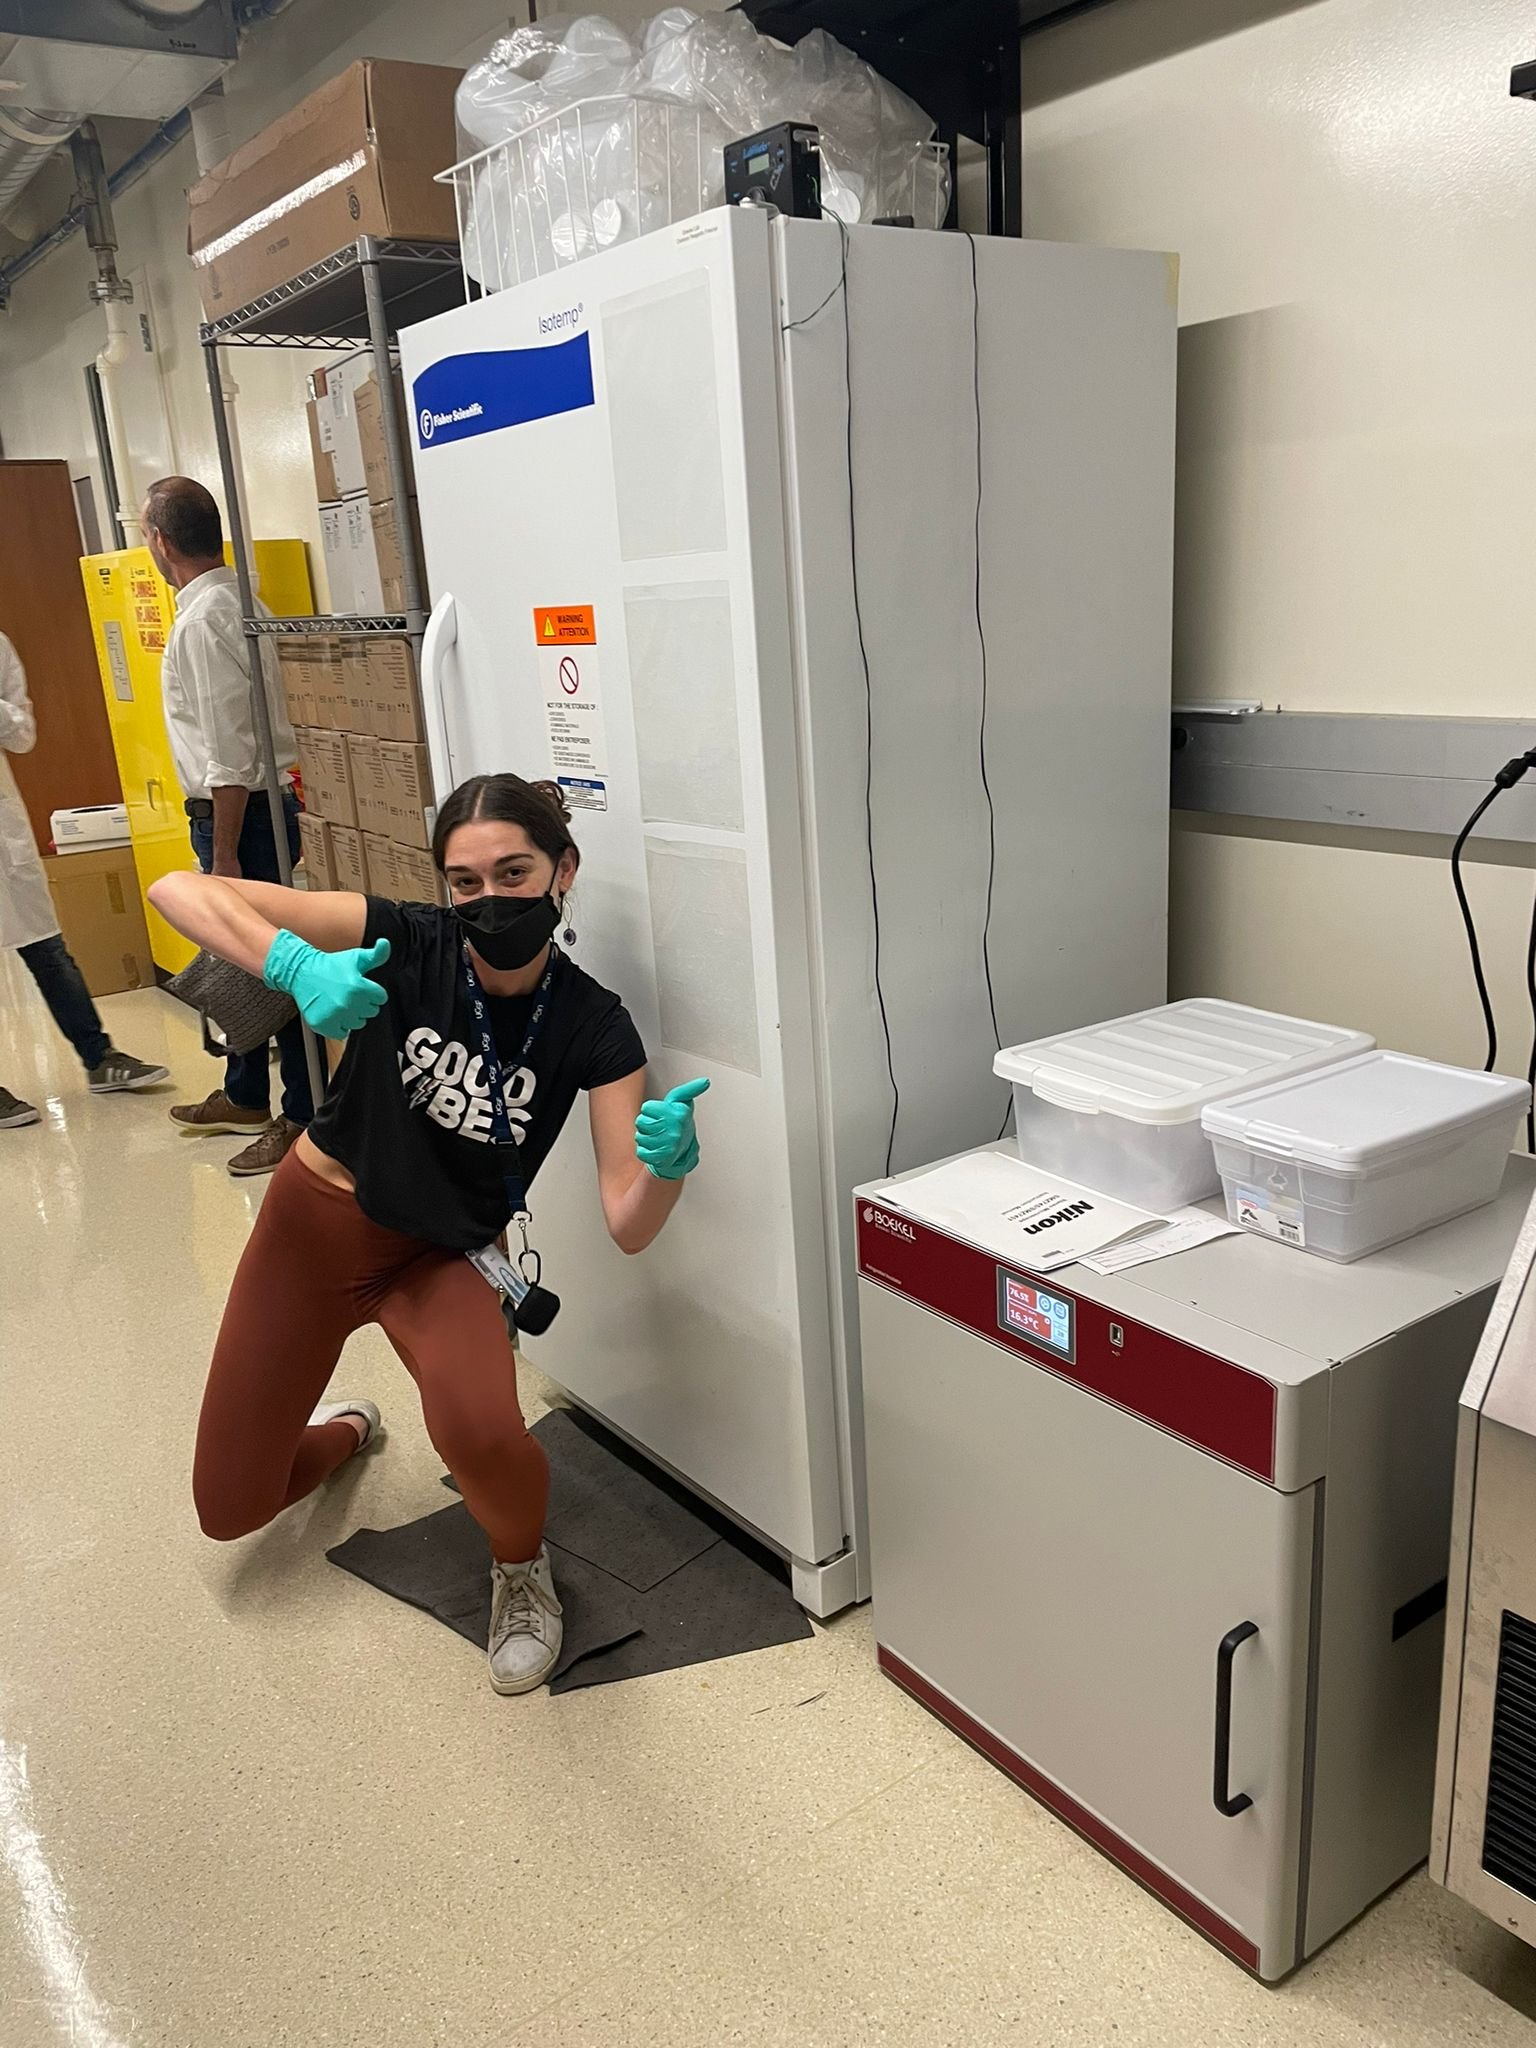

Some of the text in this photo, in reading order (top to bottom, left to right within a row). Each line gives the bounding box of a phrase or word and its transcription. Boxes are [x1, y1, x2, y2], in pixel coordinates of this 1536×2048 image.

[433, 412, 453, 427] Fisher
[556, 614, 583, 624] WARNING
[559, 627, 590, 637] ATTENTION
[474, 1000, 484, 1020] UCSF
[481, 1032, 491, 1052] UCSF
[404, 1026, 537, 1108] GOOD
[874, 1210, 917, 1240] BOEKEL
[1023, 1200, 1095, 1235] Nikon
[1009, 1287, 1030, 1303] 76.5%
[1010, 1309, 1040, 1330] 16.3°C
